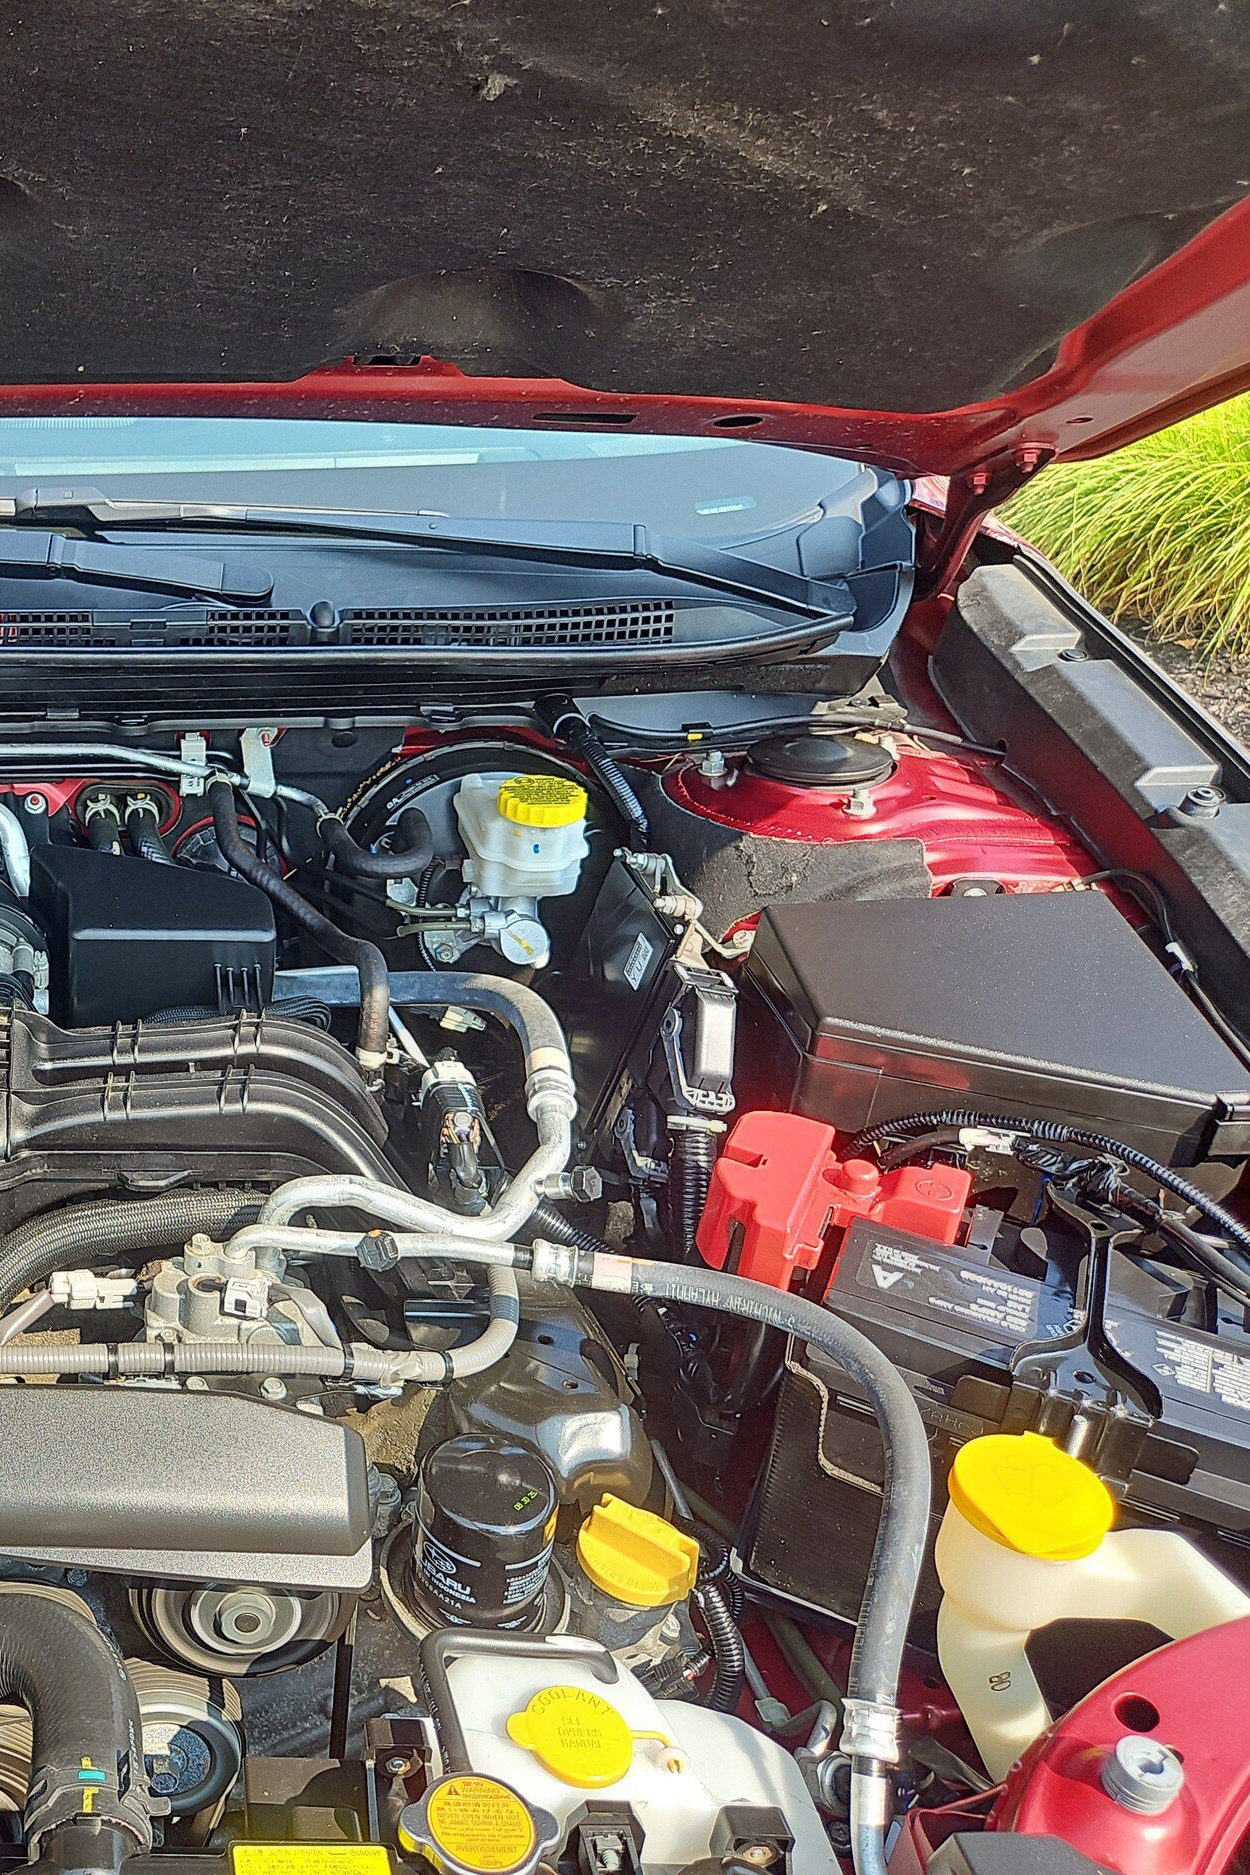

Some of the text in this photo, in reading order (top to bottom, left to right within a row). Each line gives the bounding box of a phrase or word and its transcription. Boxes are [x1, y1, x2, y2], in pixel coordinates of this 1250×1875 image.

[419, 1559, 472, 1596] UBARU
[531, 1688, 615, 1716] COOLANT
[461, 1786, 500, 1794] WARNING
[437, 1812, 460, 1820] NEVER
[455, 1844, 518, 1853] AVERTISSEMENT
